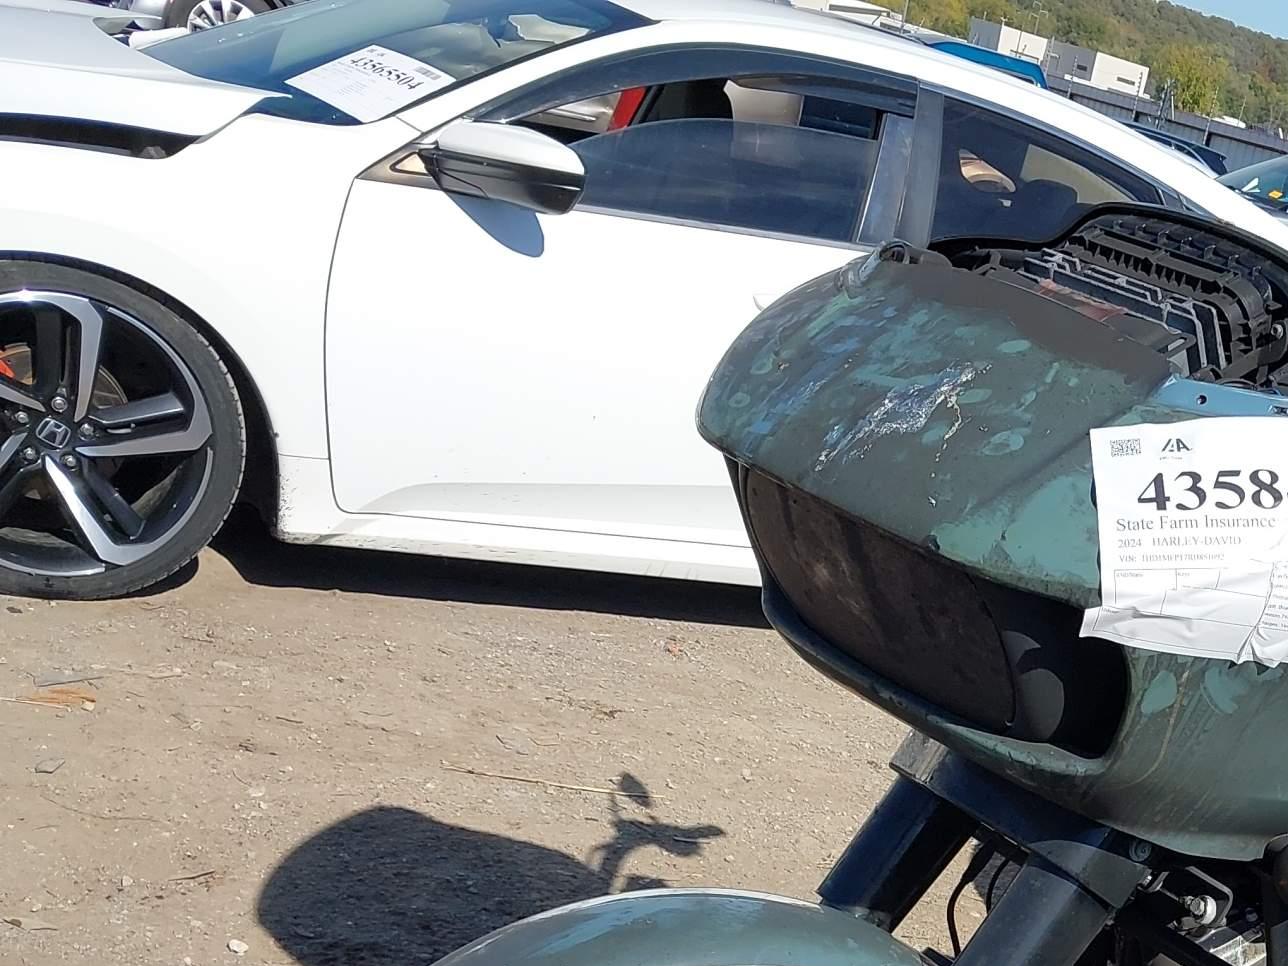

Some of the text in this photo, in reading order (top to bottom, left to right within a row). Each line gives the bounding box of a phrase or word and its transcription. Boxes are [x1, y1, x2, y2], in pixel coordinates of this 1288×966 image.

[1116, 514, 1276, 531] State Farm Insurance
[1118, 538, 1142, 548] 2024
[1119, 555, 1137, 563] VIN:
